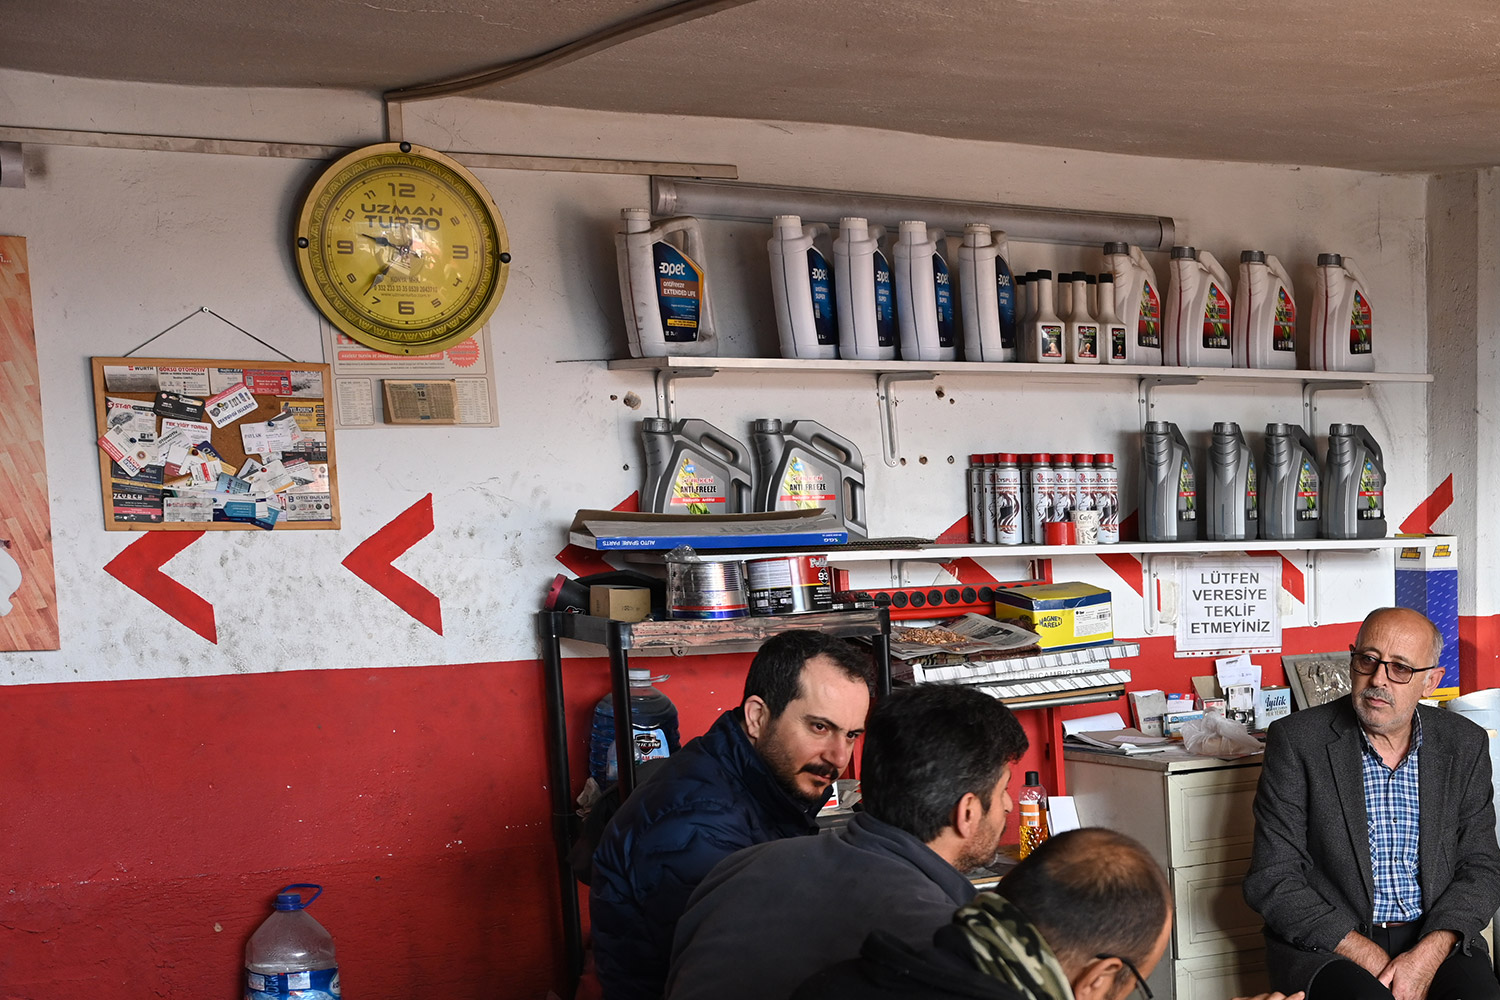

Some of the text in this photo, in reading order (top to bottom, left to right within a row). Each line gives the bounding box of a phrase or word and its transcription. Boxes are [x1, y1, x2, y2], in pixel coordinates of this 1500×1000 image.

[364, 190, 376, 200] 11
[388, 183, 416, 198] 12
[430, 193, 436, 201] 1
[342, 209, 355, 223] 10
[361, 203, 443, 216] UZMAN
[450, 216, 460, 226] 2
[337, 240, 354, 255] 9
[452, 245, 469, 259] 3
[346, 273, 357, 283] 8
[453, 278, 463, 287] 4
[372, 296, 381, 305] 7
[431, 298, 442, 309] 5
[398, 301, 415, 315] 6
[1201, 570, 1259, 584] LÜTFEN
[1192, 586, 1267, 601] VERESİYE
[1204, 603, 1256, 617] TEKLİF
[1191, 618, 1270, 634] ETMEYİNİZ
